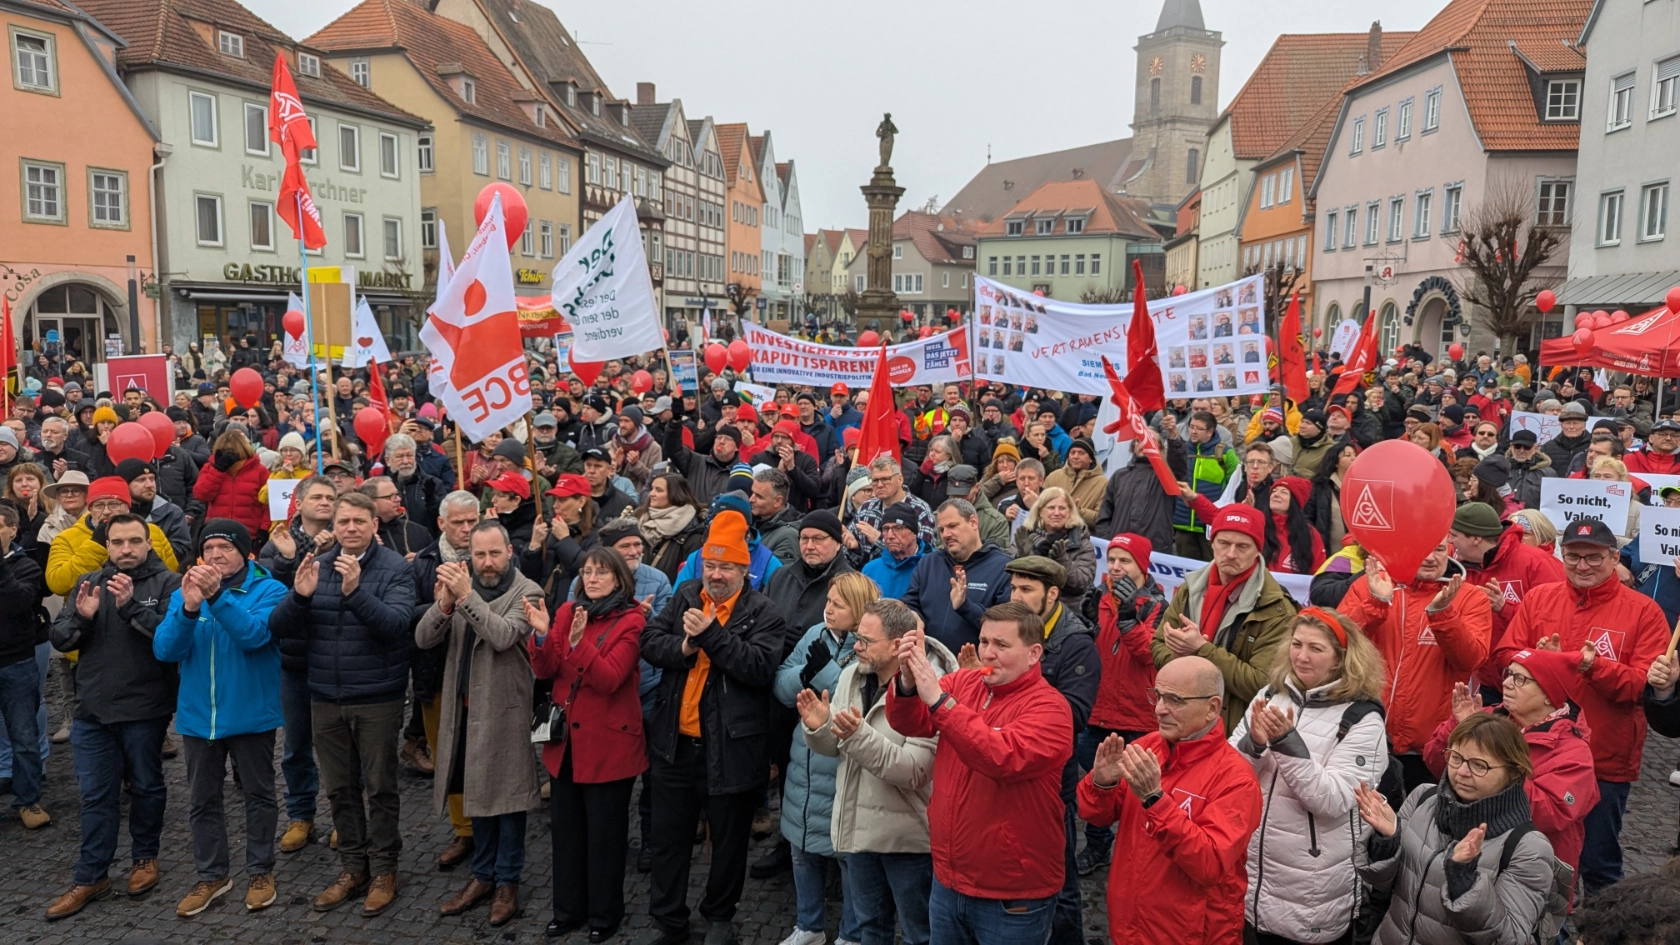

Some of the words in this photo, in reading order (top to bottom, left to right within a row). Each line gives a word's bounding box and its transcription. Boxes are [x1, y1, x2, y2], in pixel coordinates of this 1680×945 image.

[312, 178, 366, 203] rchner
[223, 262, 302, 284] GASTHO
[359, 270, 413, 288] MARKT
[518, 269, 546, 284] Tchibo
[518, 309, 561, 320] NKISCHE
[518, 322, 549, 331] nigsberg
[1031, 306, 1176, 360] VERTRAUENSLTE
[750, 330, 848, 356] INVESTIEREN
[852, 348, 898, 357] STAT
[925, 343, 942, 351] WEIL
[926, 352, 939, 360] DAS
[940, 348, 958, 358] JETZT
[750, 349, 875, 373] KAPUTTSPAREN!
[926, 359, 947, 369] ZÄHLT.
[1082, 360, 1120, 371] SIEMS
[776, 368, 813, 377] INNOVATIVE
[814, 372, 873, 381] INDUSTRIEPOLITIK.
[1558, 494, 1573, 505] So
[1576, 494, 1611, 509] nicht,
[1654, 524, 1669, 536] So
[1671, 525, 1680, 537] ni
[709, 545, 726, 555] FW
